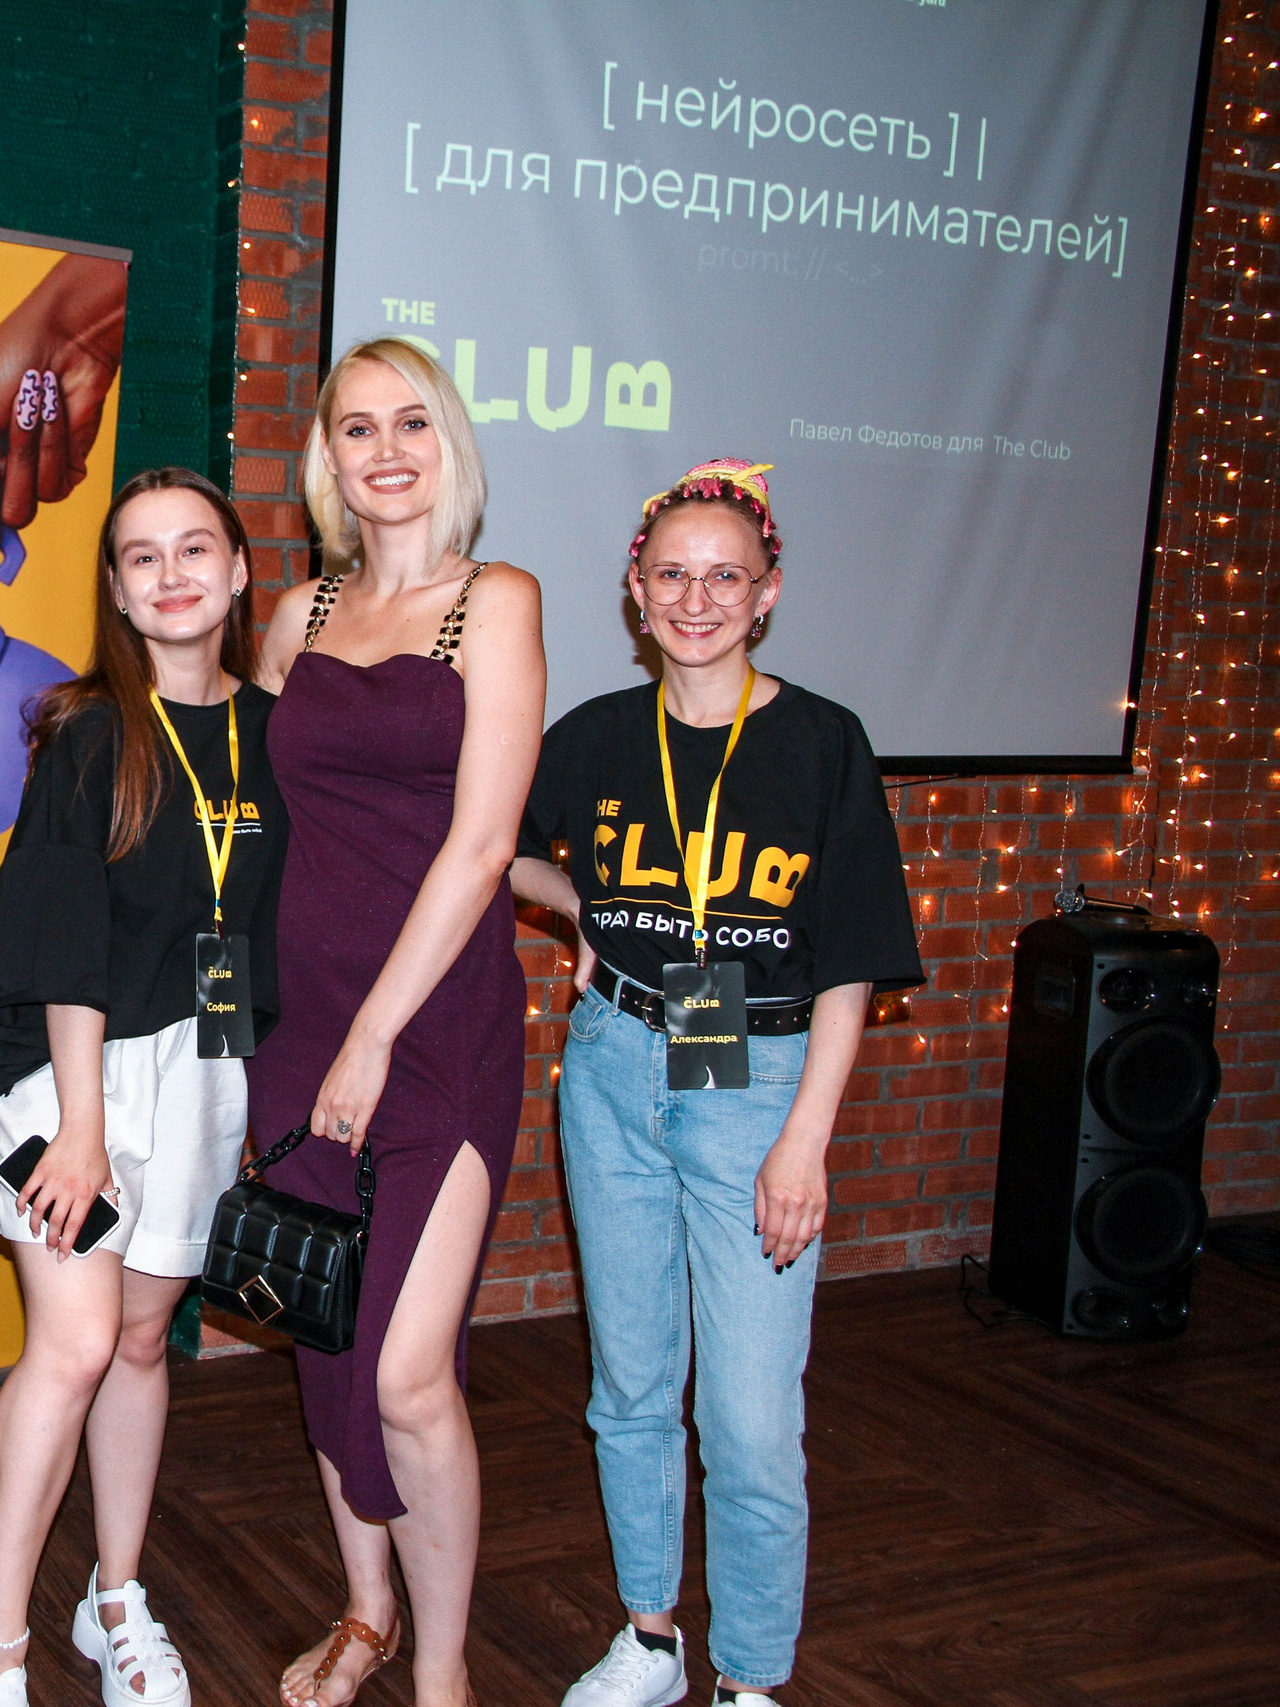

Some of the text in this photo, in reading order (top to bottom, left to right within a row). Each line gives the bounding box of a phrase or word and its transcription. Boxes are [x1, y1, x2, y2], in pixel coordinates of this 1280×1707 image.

[635, 77, 932, 161] нейросеть
[436, 142, 551, 196] для
[381, 297, 436, 326] THE
[398, 334, 672, 432] LUB
[789, 417, 1071, 462] Павел Федотов для The Club
[596, 798, 622, 817] HE
[593, 823, 811, 909] CLUB
[715, 926, 791, 949] СОБО
[208, 969, 233, 979] CLUB
[206, 1001, 236, 1014] София
[683, 999, 721, 1009] CLUB
[670, 1034, 739, 1044] Александра
